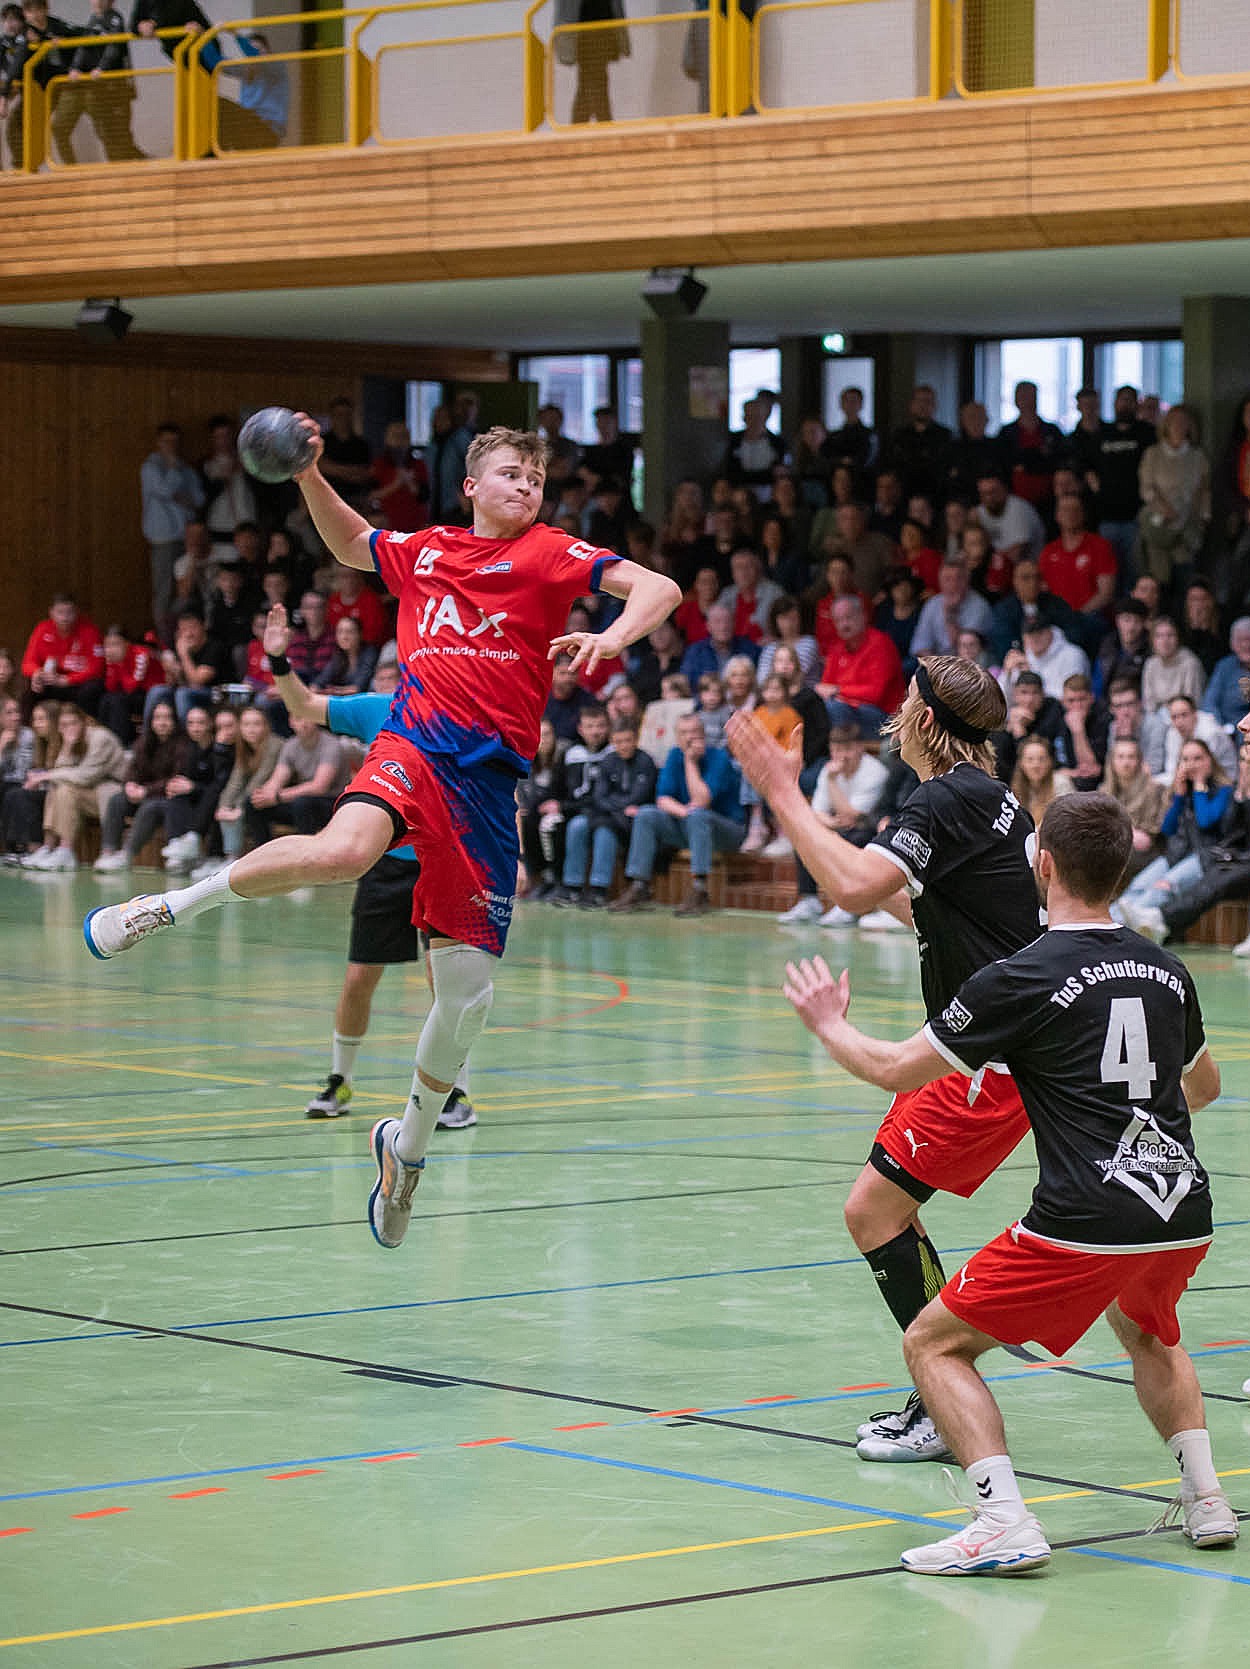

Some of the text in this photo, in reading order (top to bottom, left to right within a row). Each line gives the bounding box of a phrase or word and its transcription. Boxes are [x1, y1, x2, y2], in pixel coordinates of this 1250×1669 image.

[442, 645, 477, 657] made
[479, 647, 521, 662] simple
[991, 802, 1015, 836] TuS
[1050, 976, 1084, 1009] TuS
[1100, 997, 1156, 1100] 4
